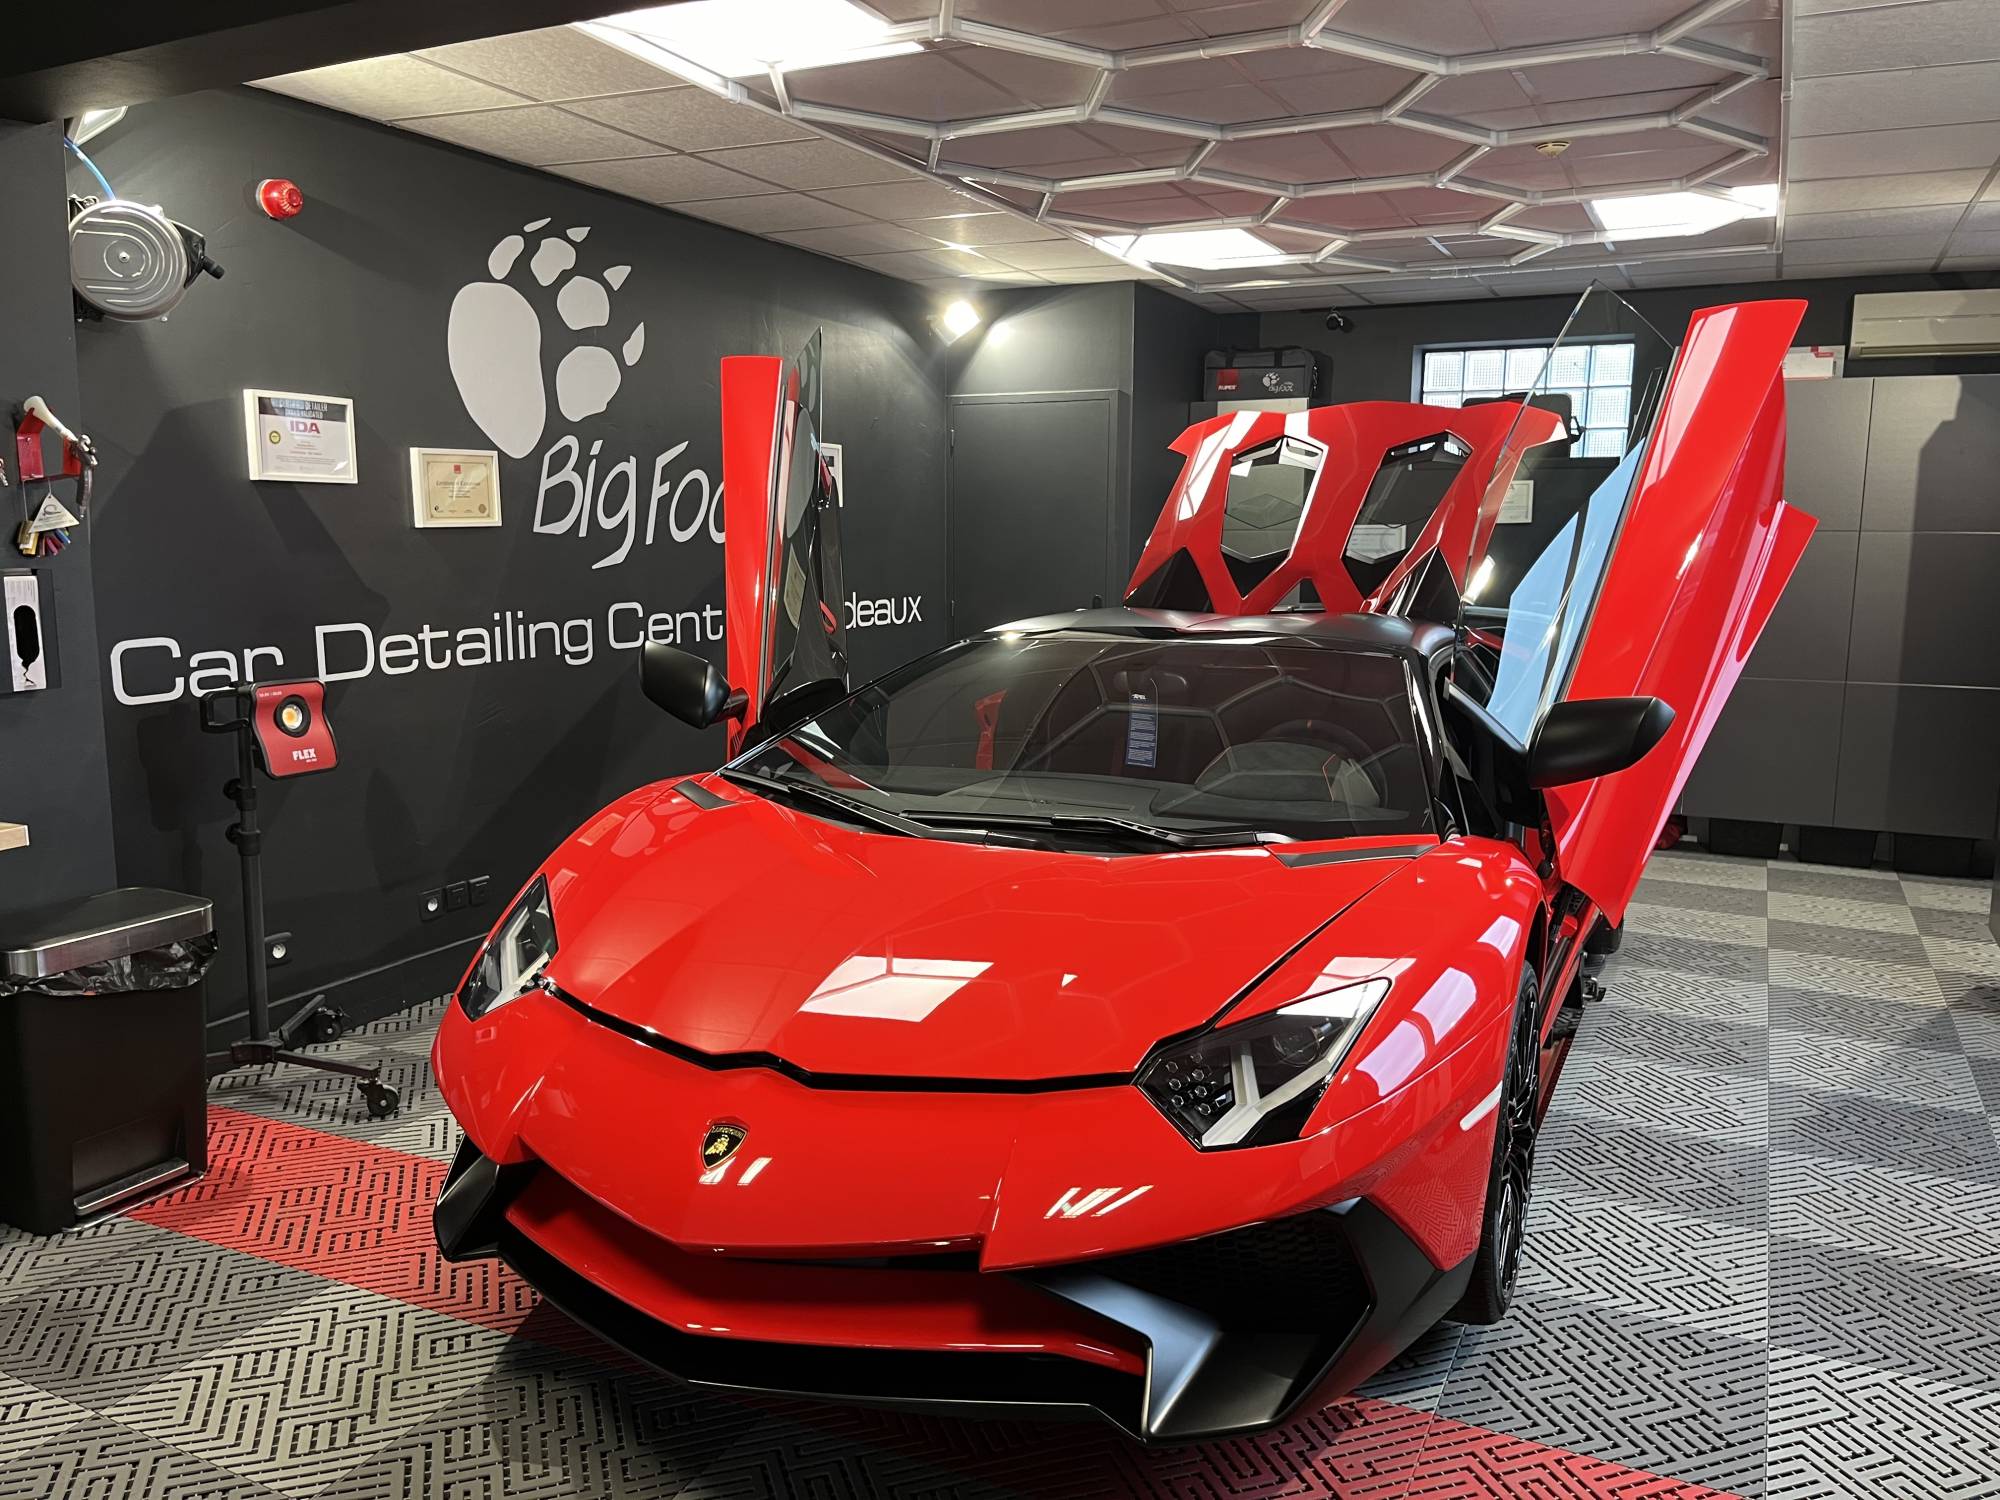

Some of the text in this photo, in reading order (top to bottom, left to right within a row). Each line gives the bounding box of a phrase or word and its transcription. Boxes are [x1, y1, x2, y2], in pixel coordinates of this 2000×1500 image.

[290, 420, 321, 434] IDA
[533, 434, 727, 569] BigFo
[110, 591, 923, 706] Car Detailing Cent deaux
[292, 747, 317, 761] FLEX
